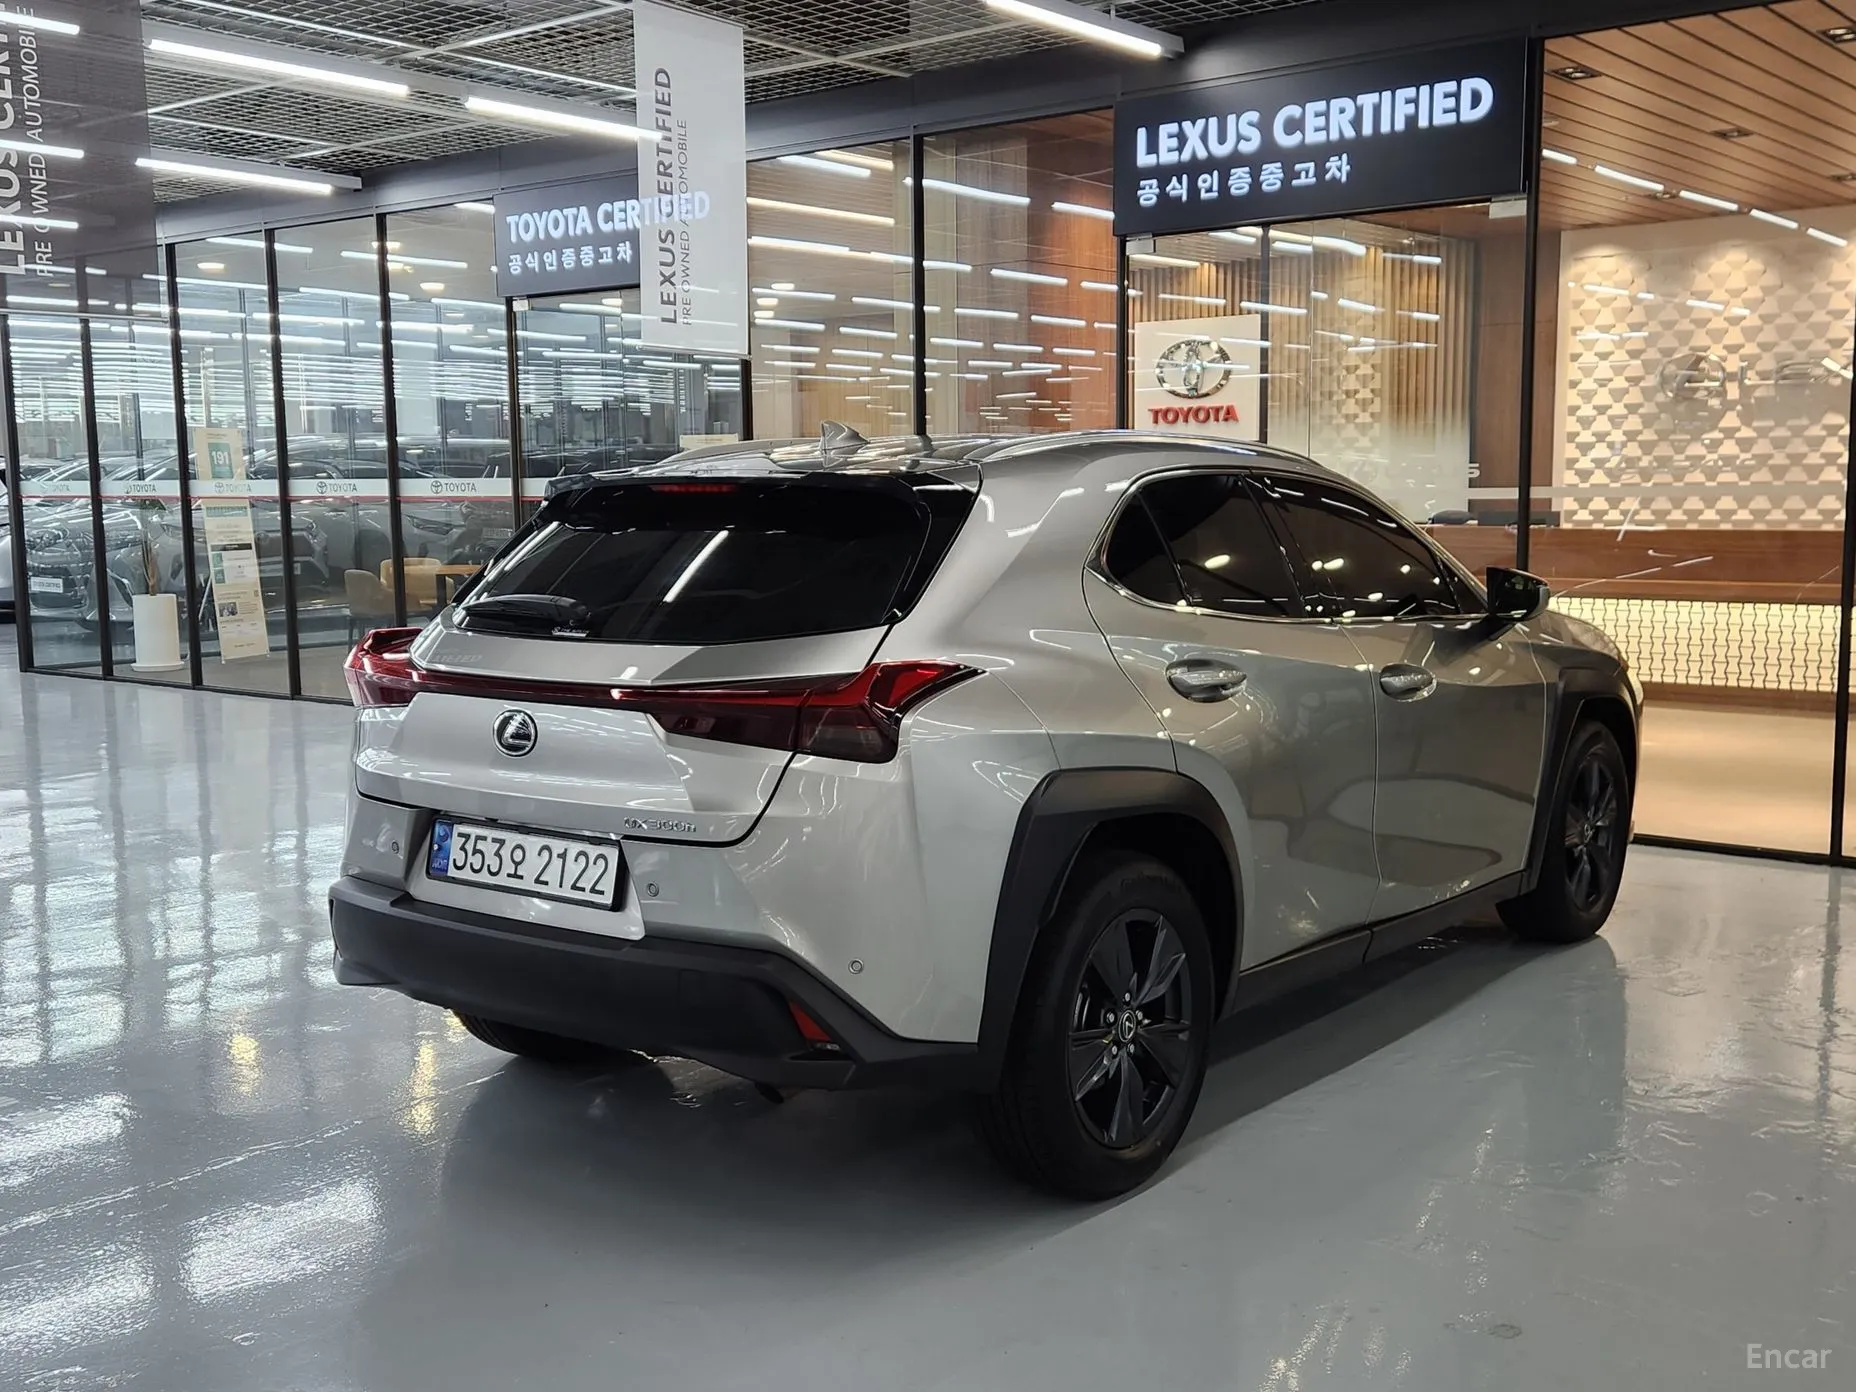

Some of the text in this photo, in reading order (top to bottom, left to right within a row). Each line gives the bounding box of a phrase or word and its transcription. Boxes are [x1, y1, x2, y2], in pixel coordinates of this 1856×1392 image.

[1136, 77, 1495, 168] LEXUS CERTIFIED
[506, 190, 711, 244] TOYOTA CERTIFIED
[676, 119, 692, 326] PRE OWNED AOMOBILE
[34, 240, 54, 276] PRE
[658, 228, 677, 324] LEXUS
[1148, 404, 1239, 425] TOYOTA
[211, 450, 230, 465] 191
[132, 483, 157, 493] TOYOTA
[225, 483, 252, 493] TOYOTA
[328, 482, 358, 493] TOYOTA
[444, 482, 477, 493] TOYOTA
[452, 832, 609, 896] 353오 2122
